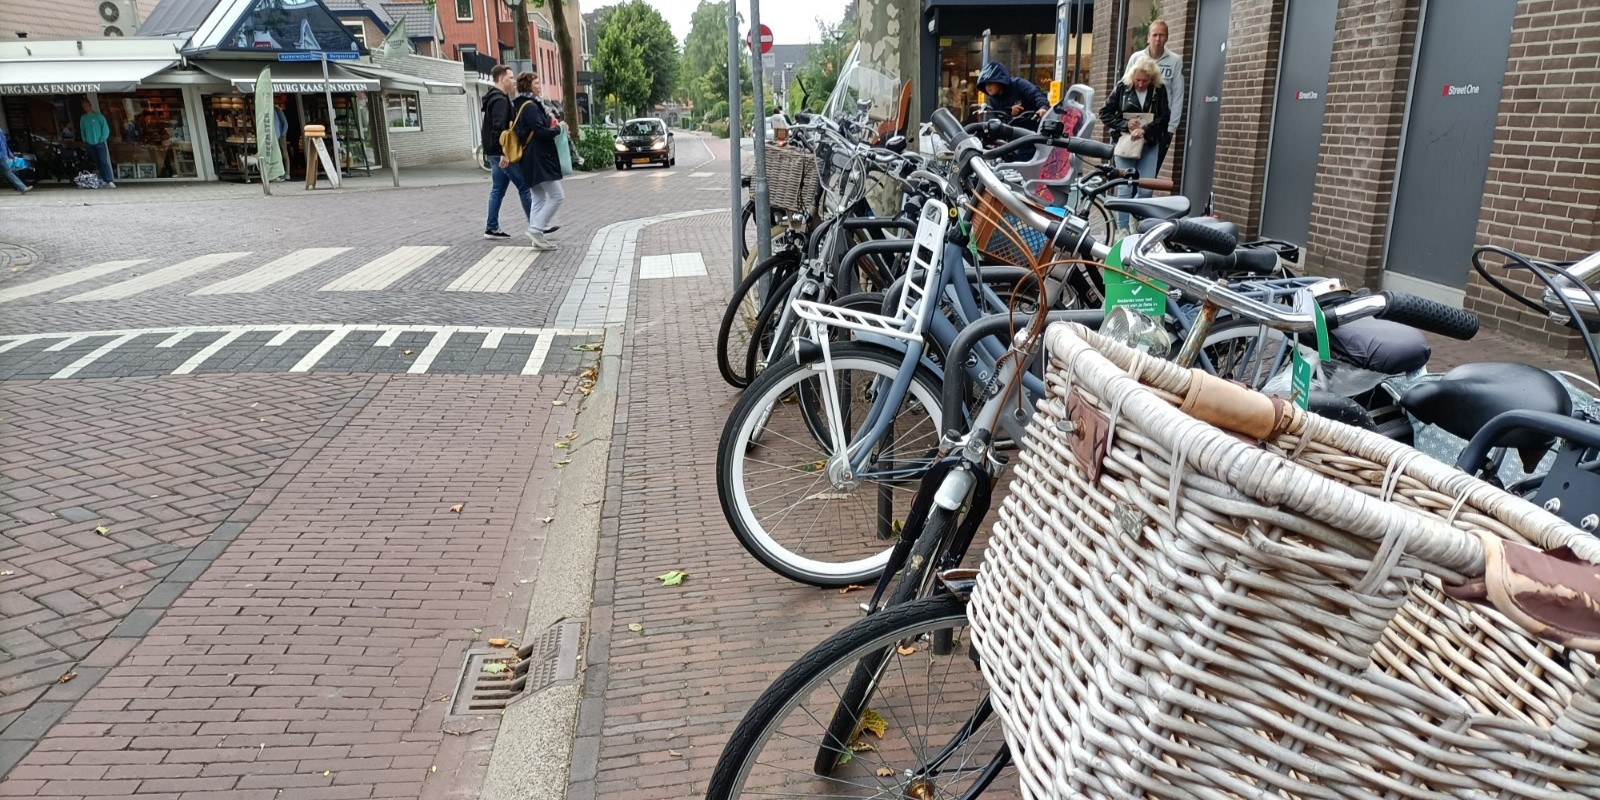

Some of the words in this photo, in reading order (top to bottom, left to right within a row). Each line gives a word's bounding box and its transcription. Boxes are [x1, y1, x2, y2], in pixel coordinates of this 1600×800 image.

[23, 85, 50, 94] KAAS
[51, 84, 64, 93] EN
[66, 83, 101, 93] NOTEN
[300, 83, 324, 93] KAAS
[338, 83, 368, 92] NOTEN
